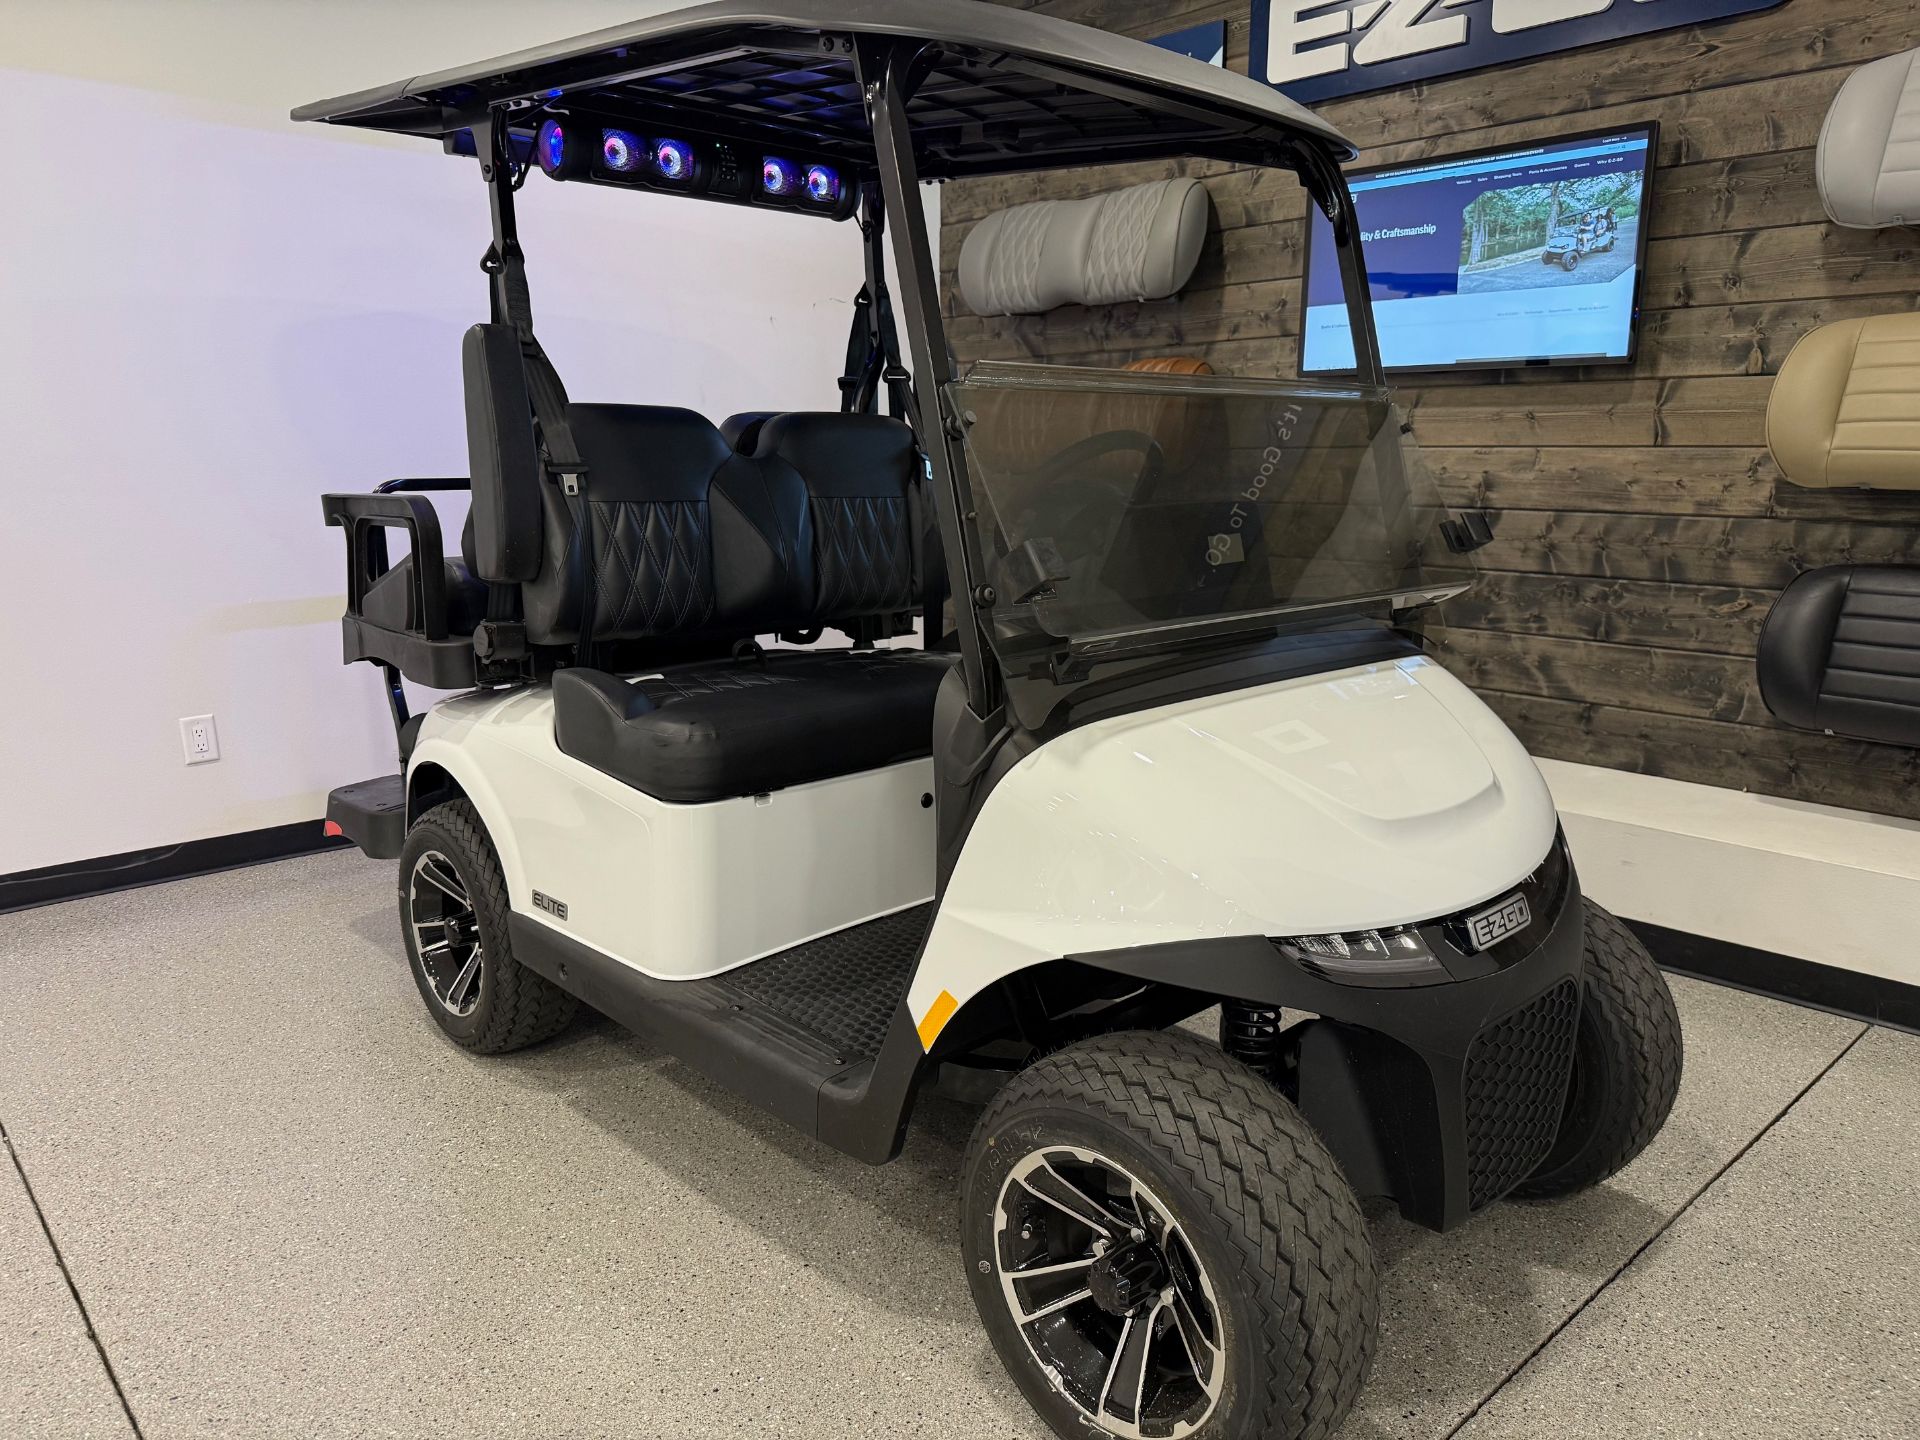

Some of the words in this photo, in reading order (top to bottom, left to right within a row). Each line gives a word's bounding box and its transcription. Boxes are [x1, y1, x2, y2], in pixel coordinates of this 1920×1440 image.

[1374, 230, 1381, 240] &
[1382, 223, 1437, 239] Craftsmanship
[533, 892, 565, 919] ELITE
[1475, 899, 1529, 944] EZGO
